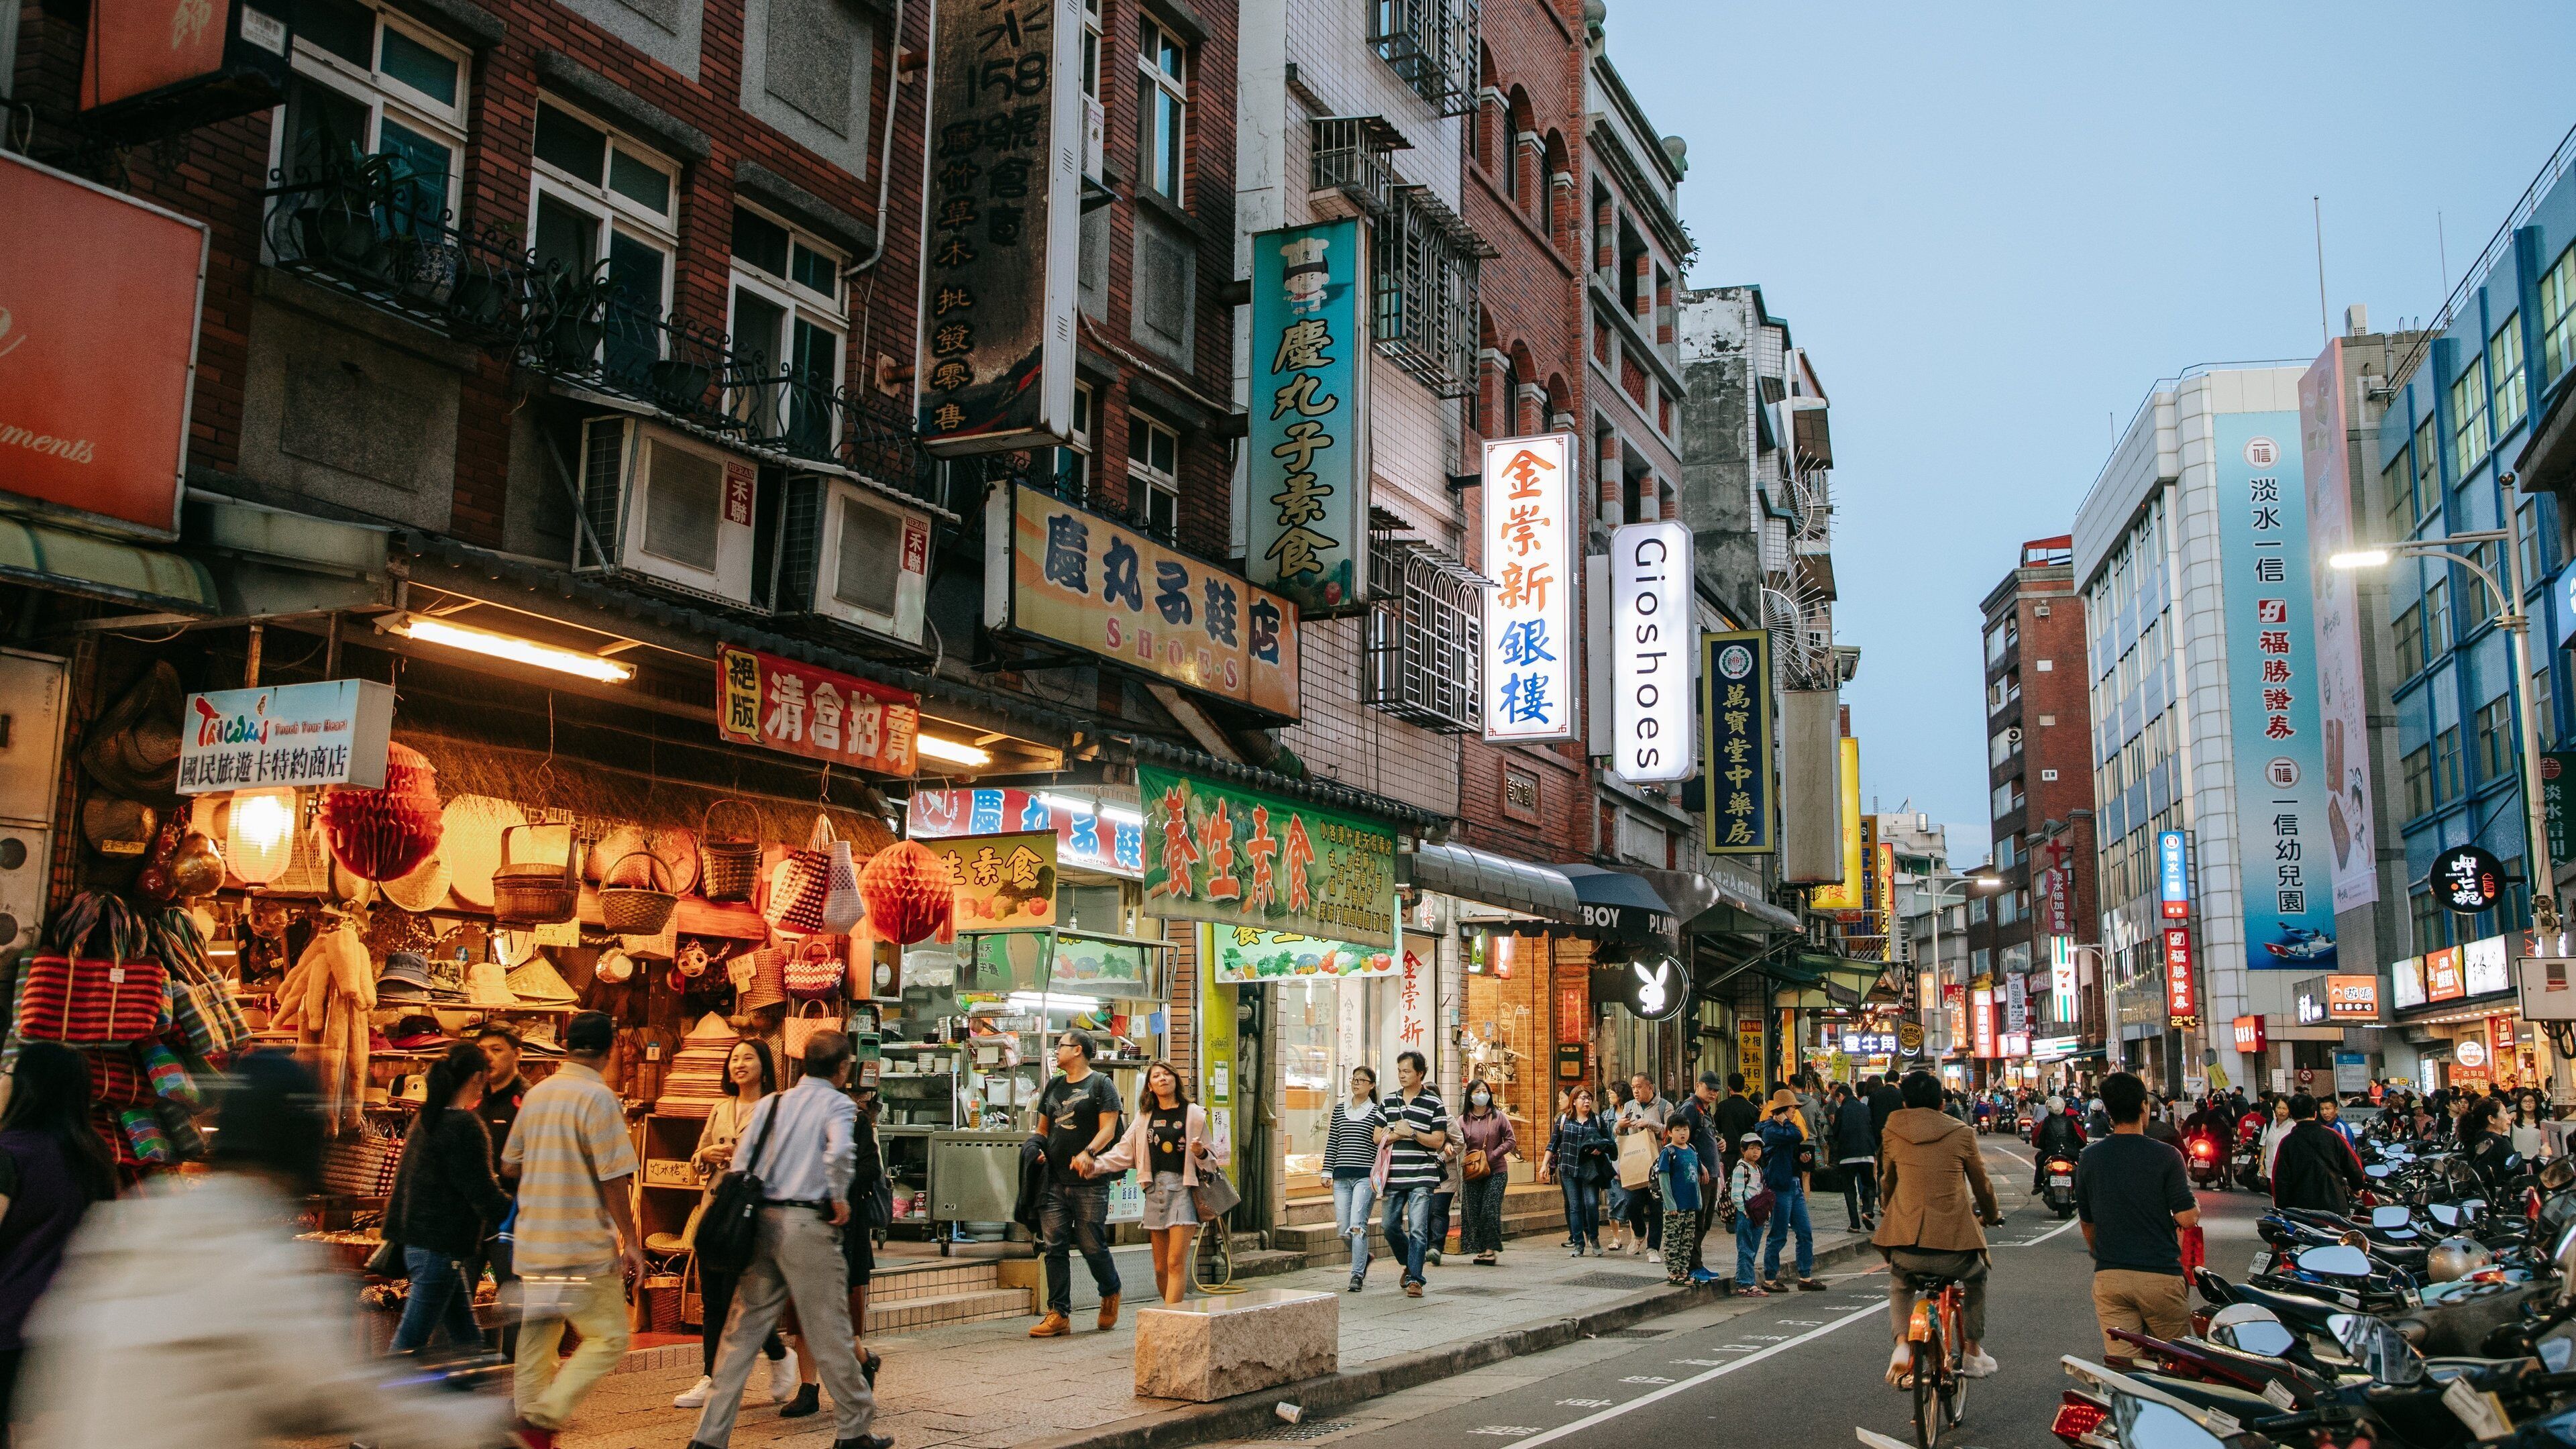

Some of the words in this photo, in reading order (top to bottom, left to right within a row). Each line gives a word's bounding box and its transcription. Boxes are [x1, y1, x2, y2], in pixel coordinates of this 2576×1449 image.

[729, 463, 754, 479] HERAN
[1265, 319, 1340, 578] 慶丸子素食
[730, 480, 749, 525] 禾聯
[907, 517, 928, 531] HERAN
[2249, 478, 2286, 583] 淡水一信
[908, 533, 923, 573] 禾聯
[1044, 514, 1281, 666] 慶丸子鞋店
[1497, 449, 1556, 724] 金崇新銀樓
[729, 653, 757, 729] 絕版
[1634, 537, 1667, 769] Gioshoes
[2259, 630, 2295, 740] 福勝證券
[180, 744, 348, 787] 國民旅遊卡特約商店
[275, 722, 299, 736] Touch
[302, 720, 321, 733] Your
[323, 718, 348, 733] Heart
[765, 671, 916, 765] 清倉拍賣
[1721, 684, 1756, 845] 萬寶堂中藥房
[1162, 785, 1316, 912] 養生素食
[2271, 799, 2306, 915] 一信幼兒園
[2052, 872, 2065, 930] 淡水倍加教會
[1400, 949, 1426, 1048] 金崇新
[2170, 949, 2189, 1010] 福勝證券
